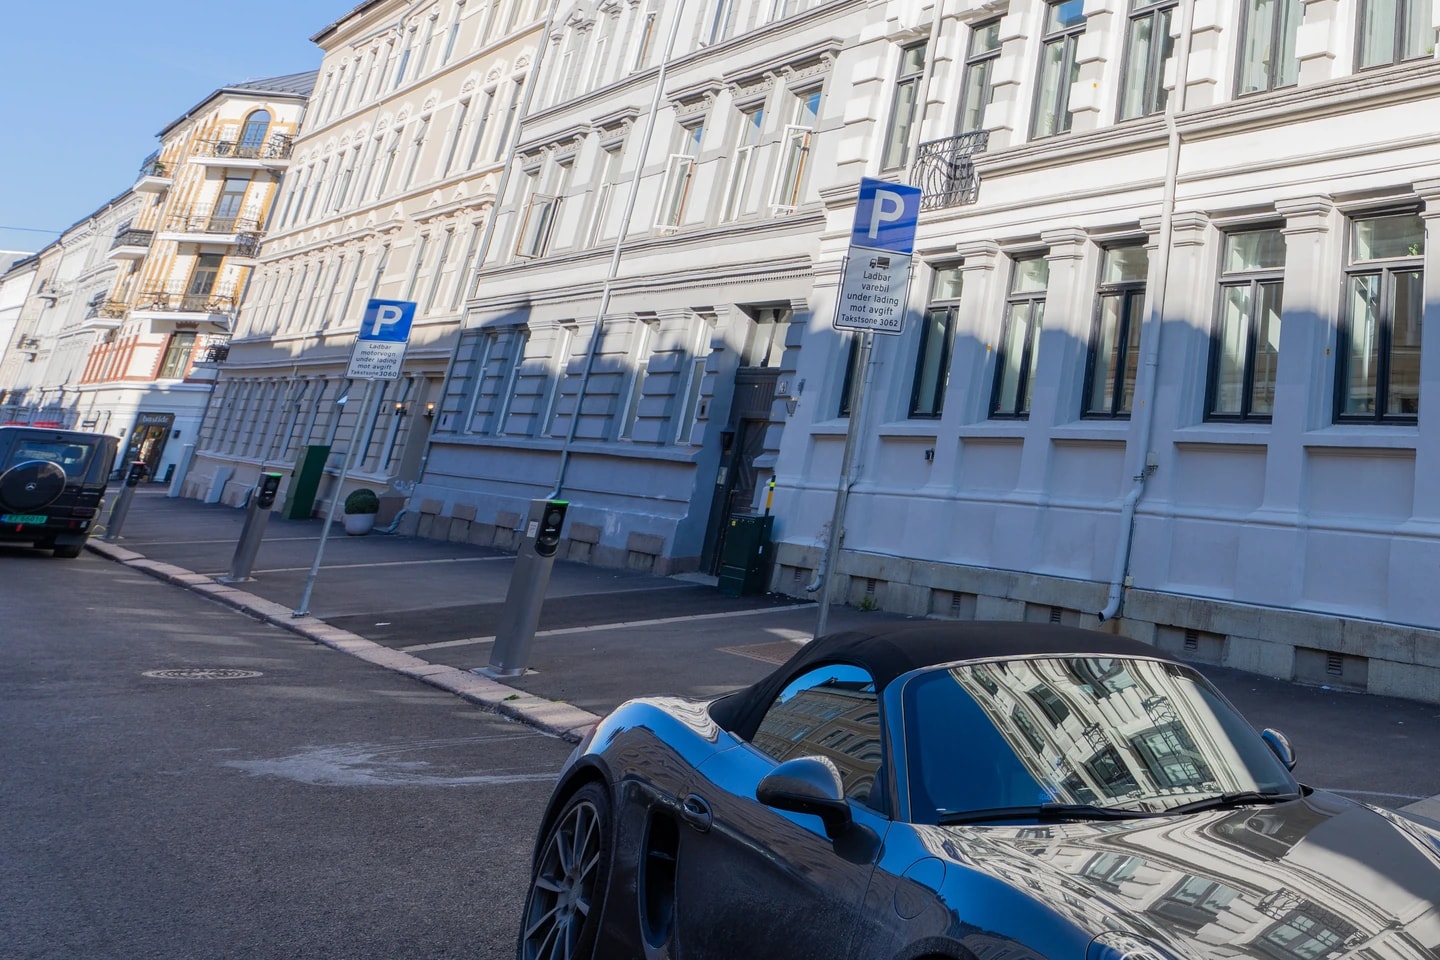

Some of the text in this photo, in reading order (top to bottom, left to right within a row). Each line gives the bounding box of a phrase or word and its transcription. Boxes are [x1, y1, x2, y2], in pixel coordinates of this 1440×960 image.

[868, 189, 905, 240] P
[863, 271, 891, 282] Ladbar
[861, 283, 889, 293] varebil
[847, 293, 899, 307] under lading
[850, 304, 893, 316] mot avgift
[371, 304, 403, 336] P
[841, 313, 898, 327] Takstsone 3062
[377, 357, 397, 365] lading
